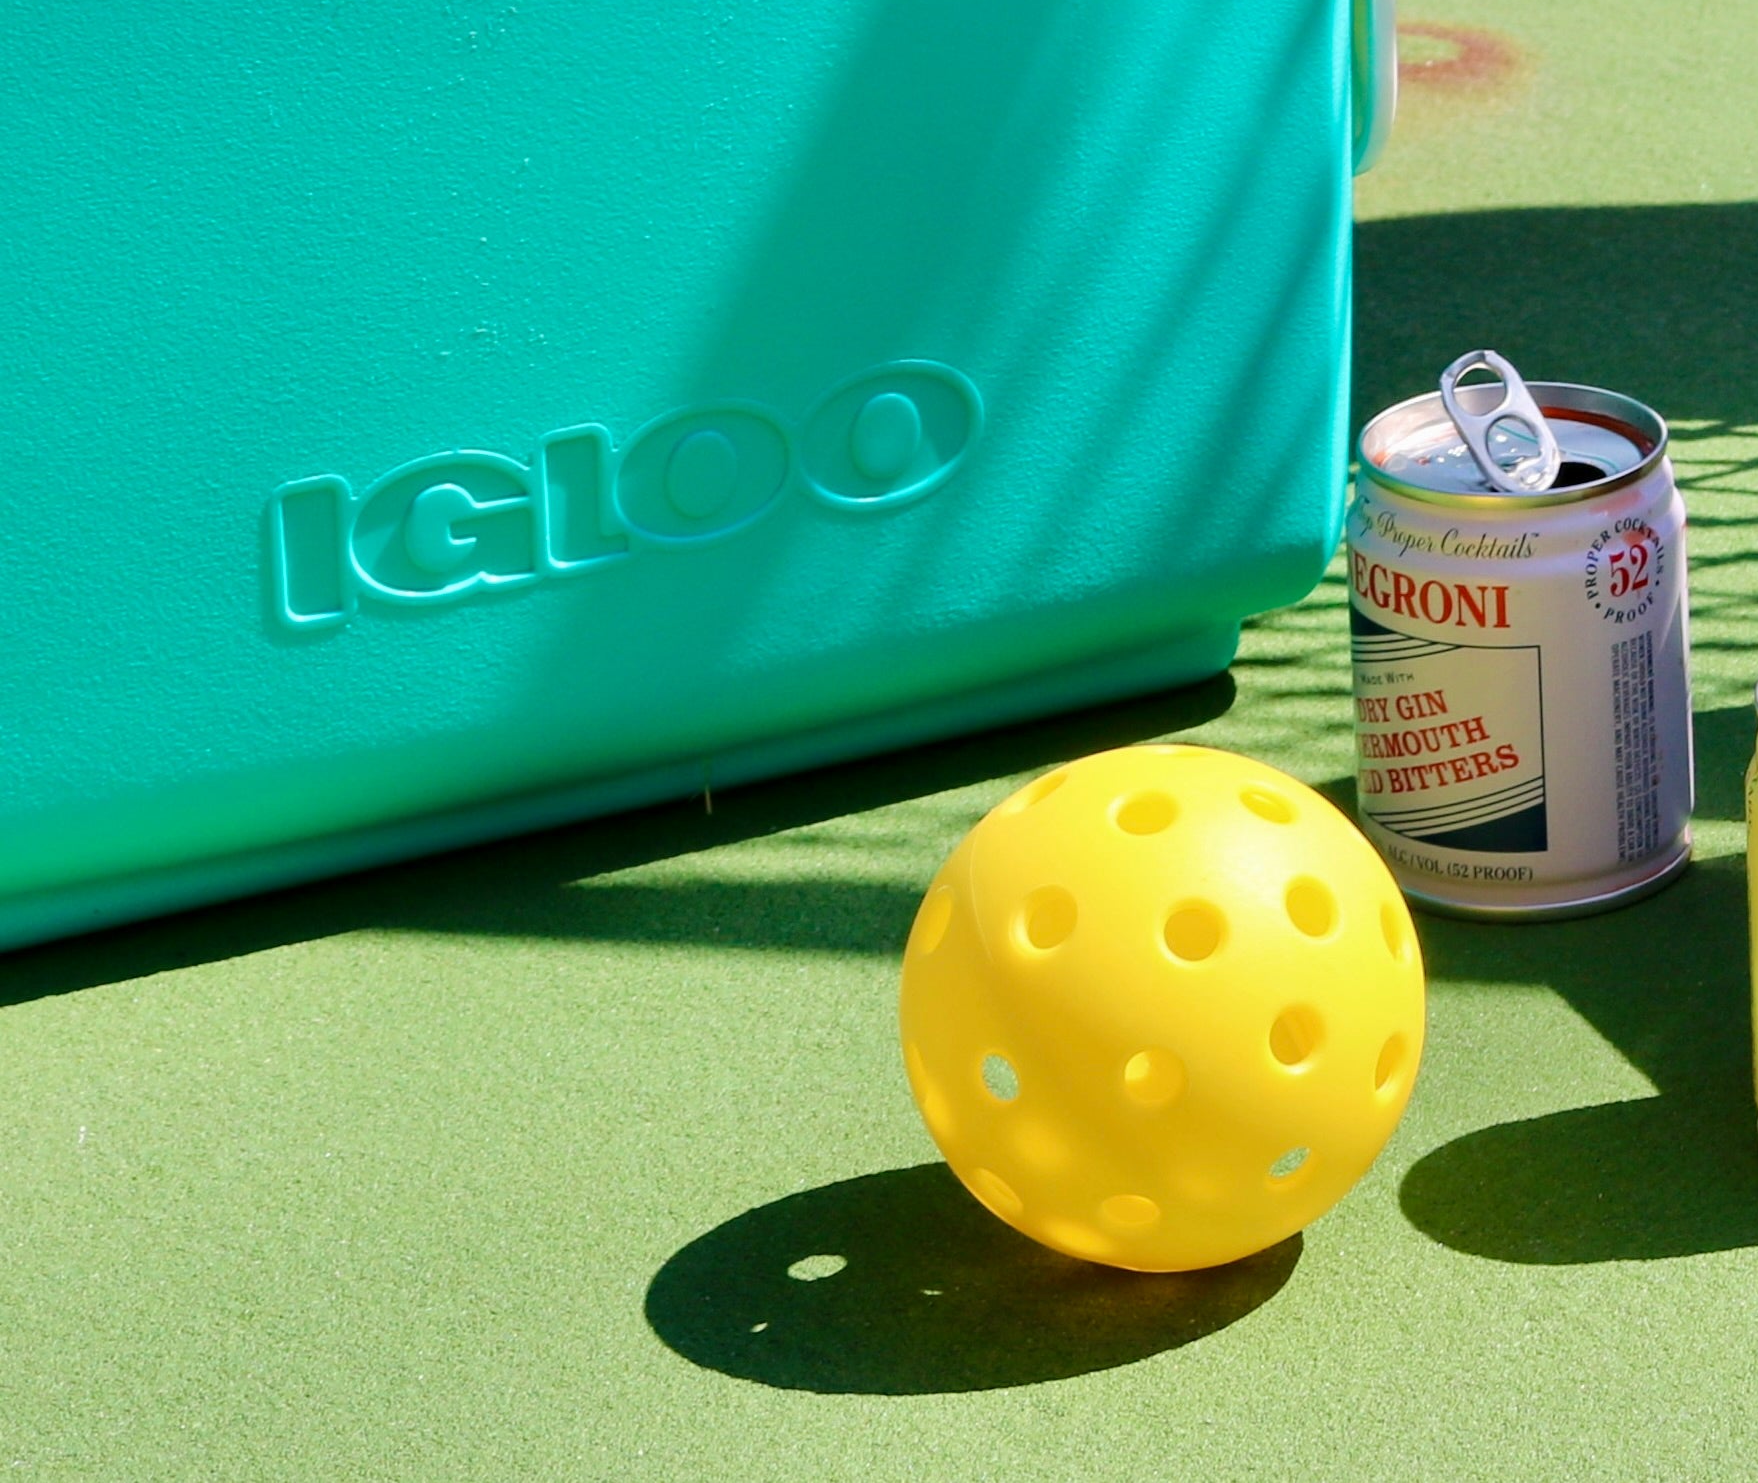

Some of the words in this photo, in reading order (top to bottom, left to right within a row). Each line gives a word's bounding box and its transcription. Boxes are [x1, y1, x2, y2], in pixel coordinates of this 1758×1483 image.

[268, 358, 986, 628] IGLOO
[1377, 511, 1434, 557] Proper
[1440, 527, 1538, 560] Cocktails
[1352, 549, 1511, 628] EGRONI
[1608, 544, 1648, 597] 52
[1603, 592, 1654, 624] PROOF
[1396, 689, 1448, 721] GIN
[1357, 716, 1491, 759] ERMOUTH
[1359, 769, 1384, 794] ED
[1387, 743, 1520, 794] BITTERS
[1416, 857, 1443, 874] VOL
[1447, 862, 1469, 880] (52
[1474, 866, 1533, 883] PROOF)
